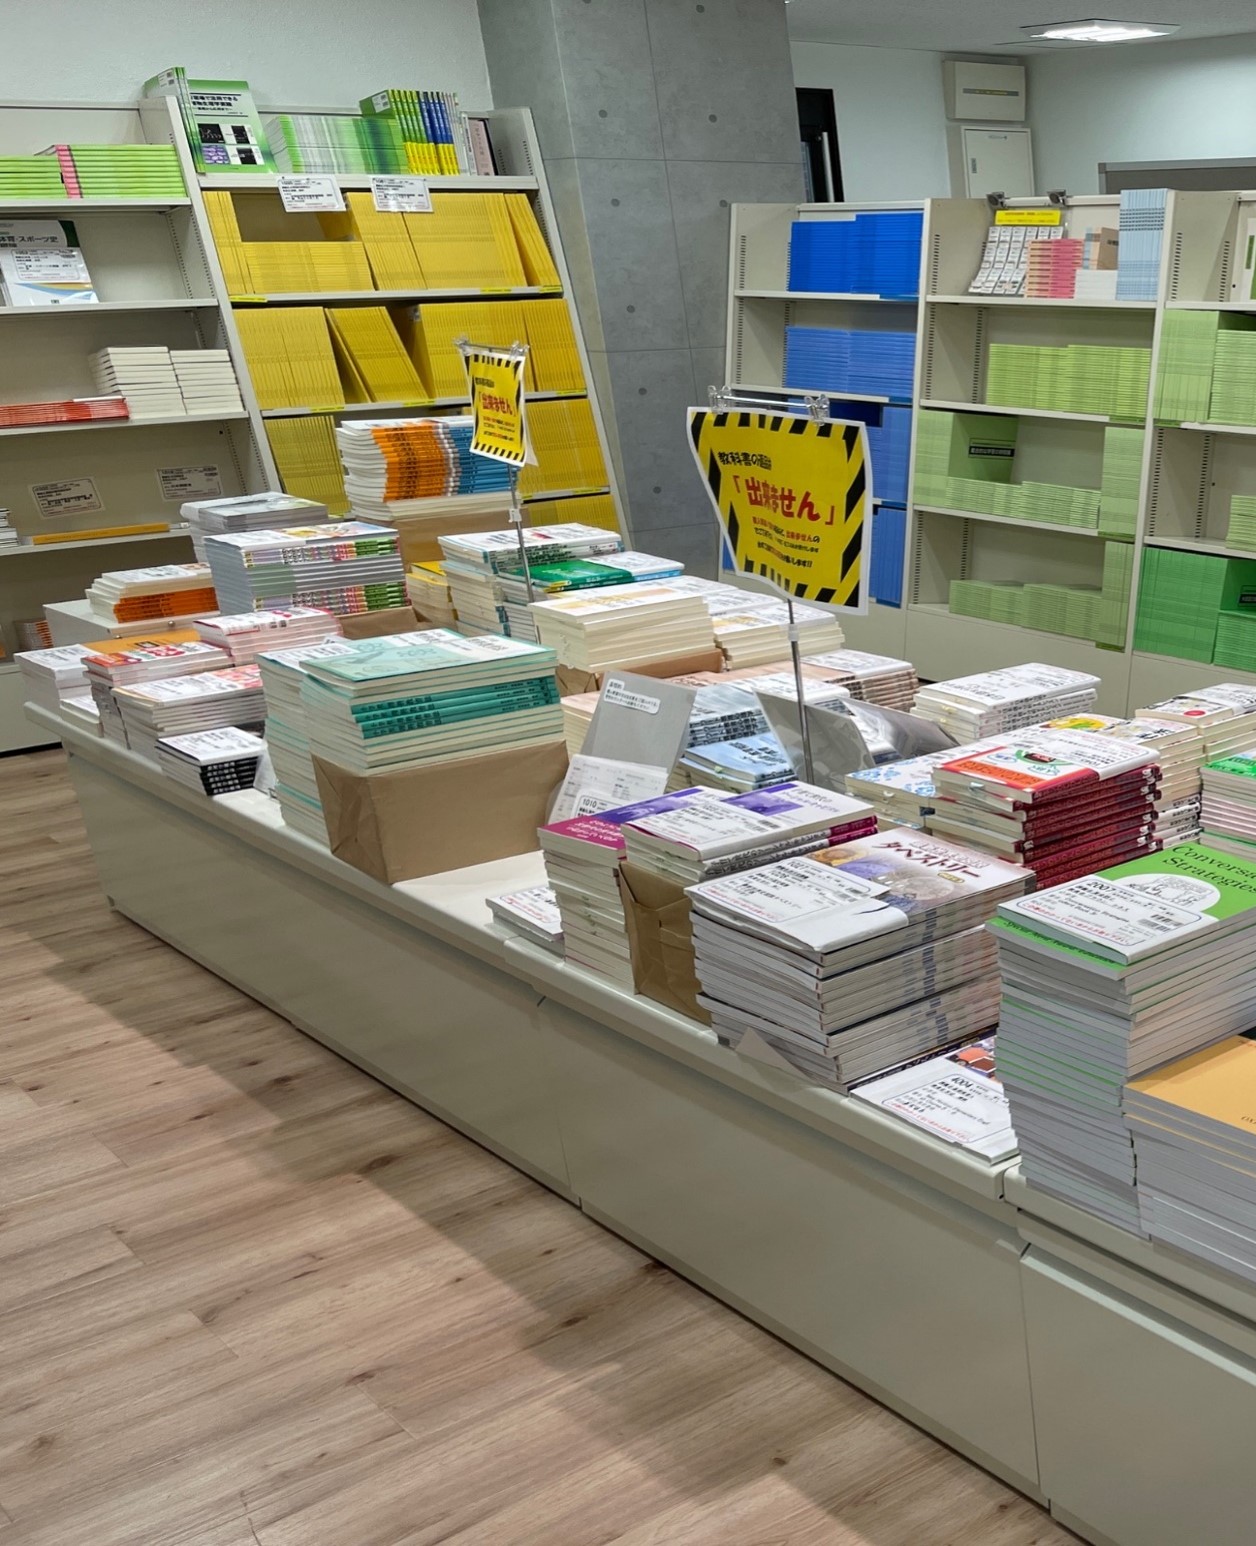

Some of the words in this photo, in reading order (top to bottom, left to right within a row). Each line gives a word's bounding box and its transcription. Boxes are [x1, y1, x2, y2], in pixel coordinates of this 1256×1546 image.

[581, 798, 598, 808] 1010
[872, 841, 982, 878] タペストリー
[1086, 880, 1117, 892] 2007
